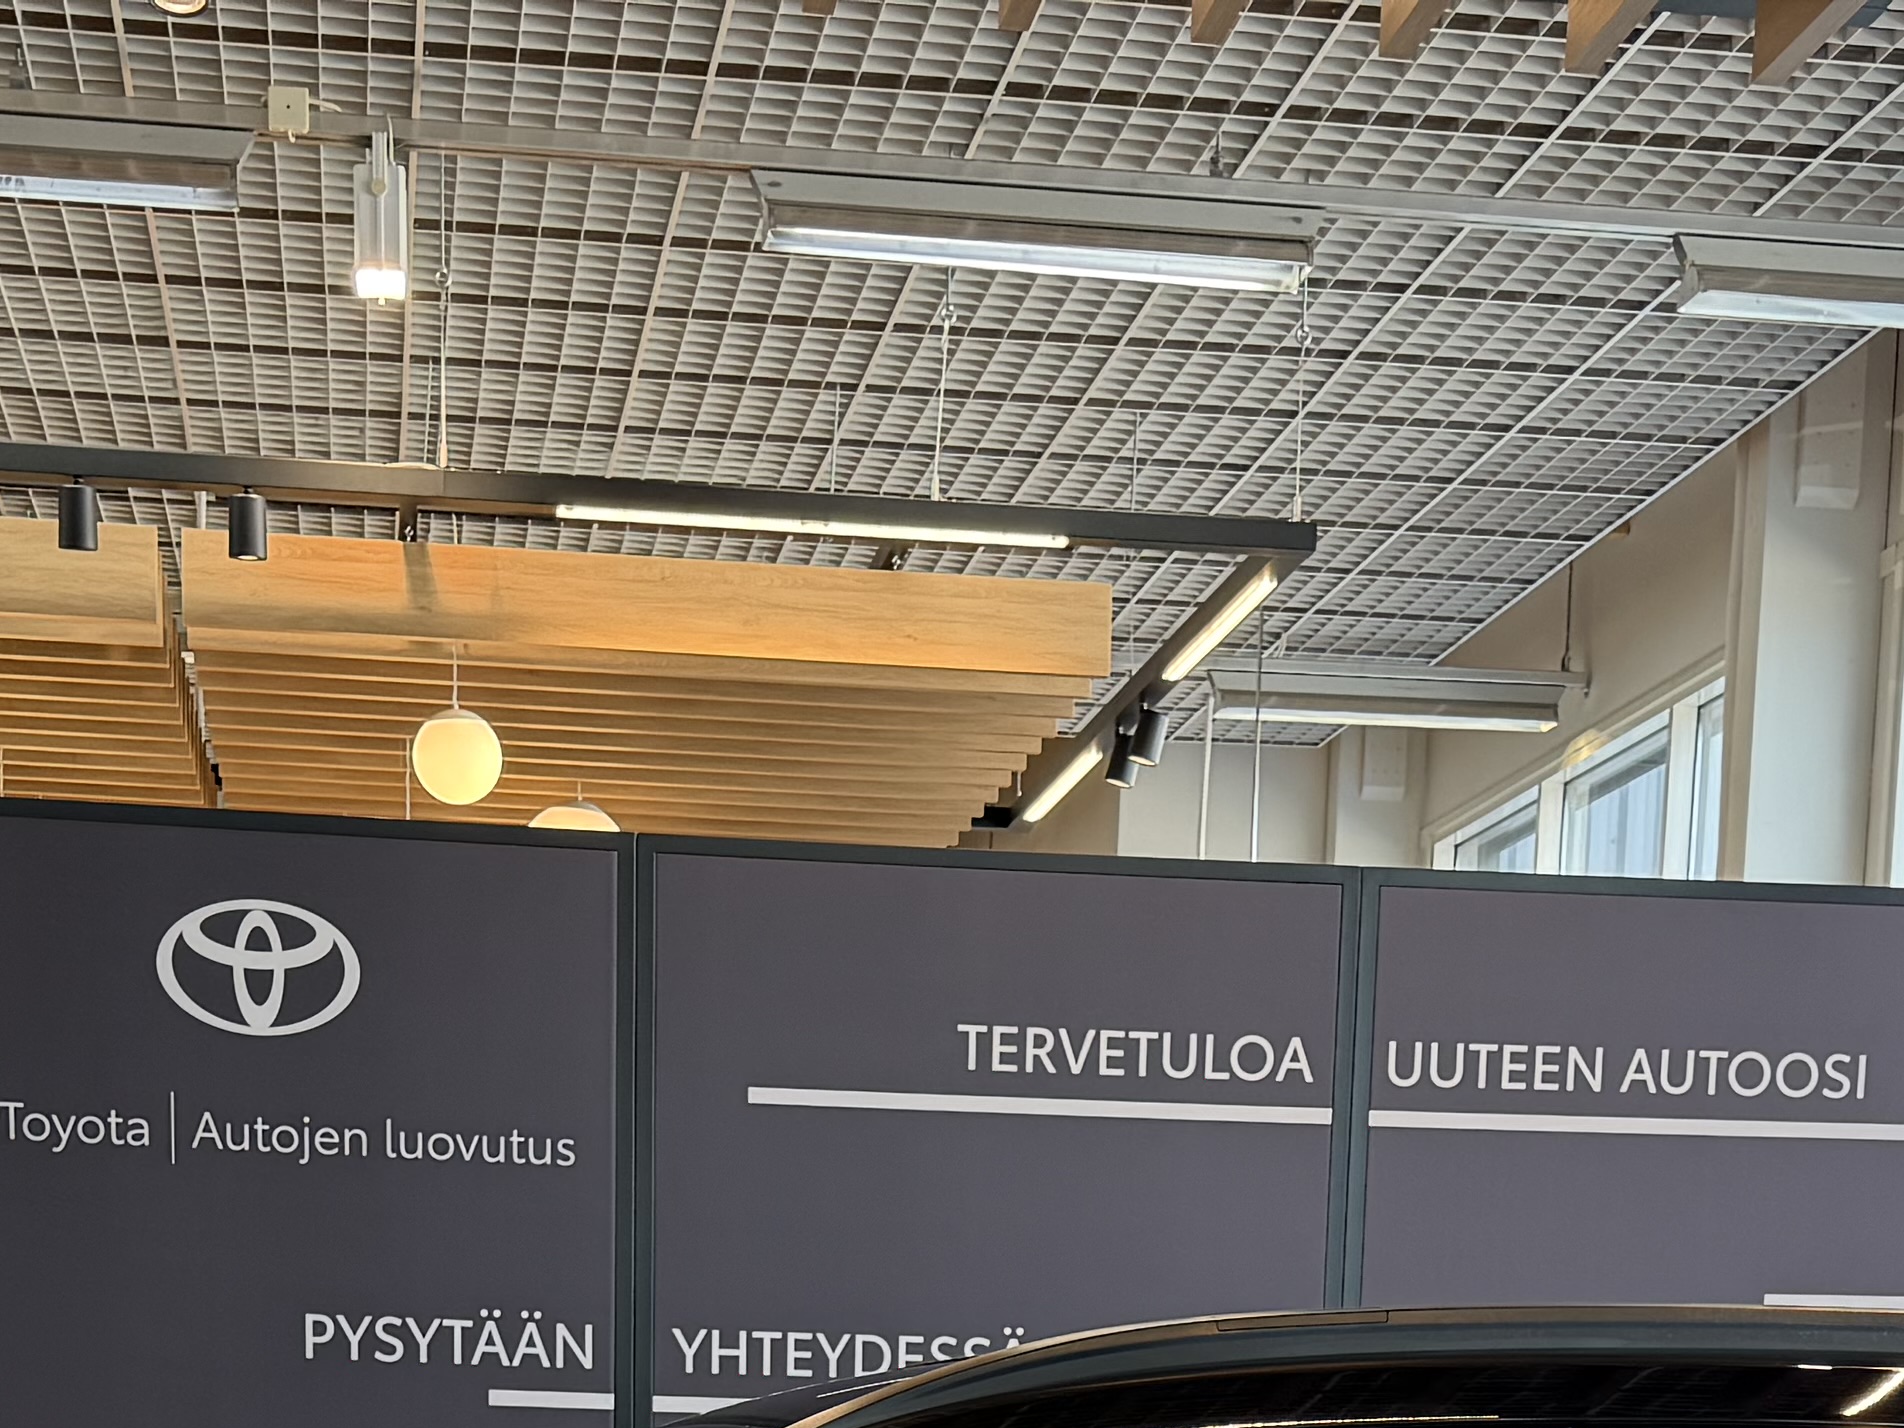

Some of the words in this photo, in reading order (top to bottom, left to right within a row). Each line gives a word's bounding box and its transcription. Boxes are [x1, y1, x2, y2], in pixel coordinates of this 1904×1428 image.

[957, 1025, 1314, 1084] TERVETULOA
[1387, 1041, 1604, 1094] UUTEEN
[1621, 1049, 1868, 1101] AUTOOSI
[192, 1110, 368, 1166] Autojen
[386, 1118, 577, 1167] luovutus
[304, 1308, 594, 1370] PYSYTÄÄN
